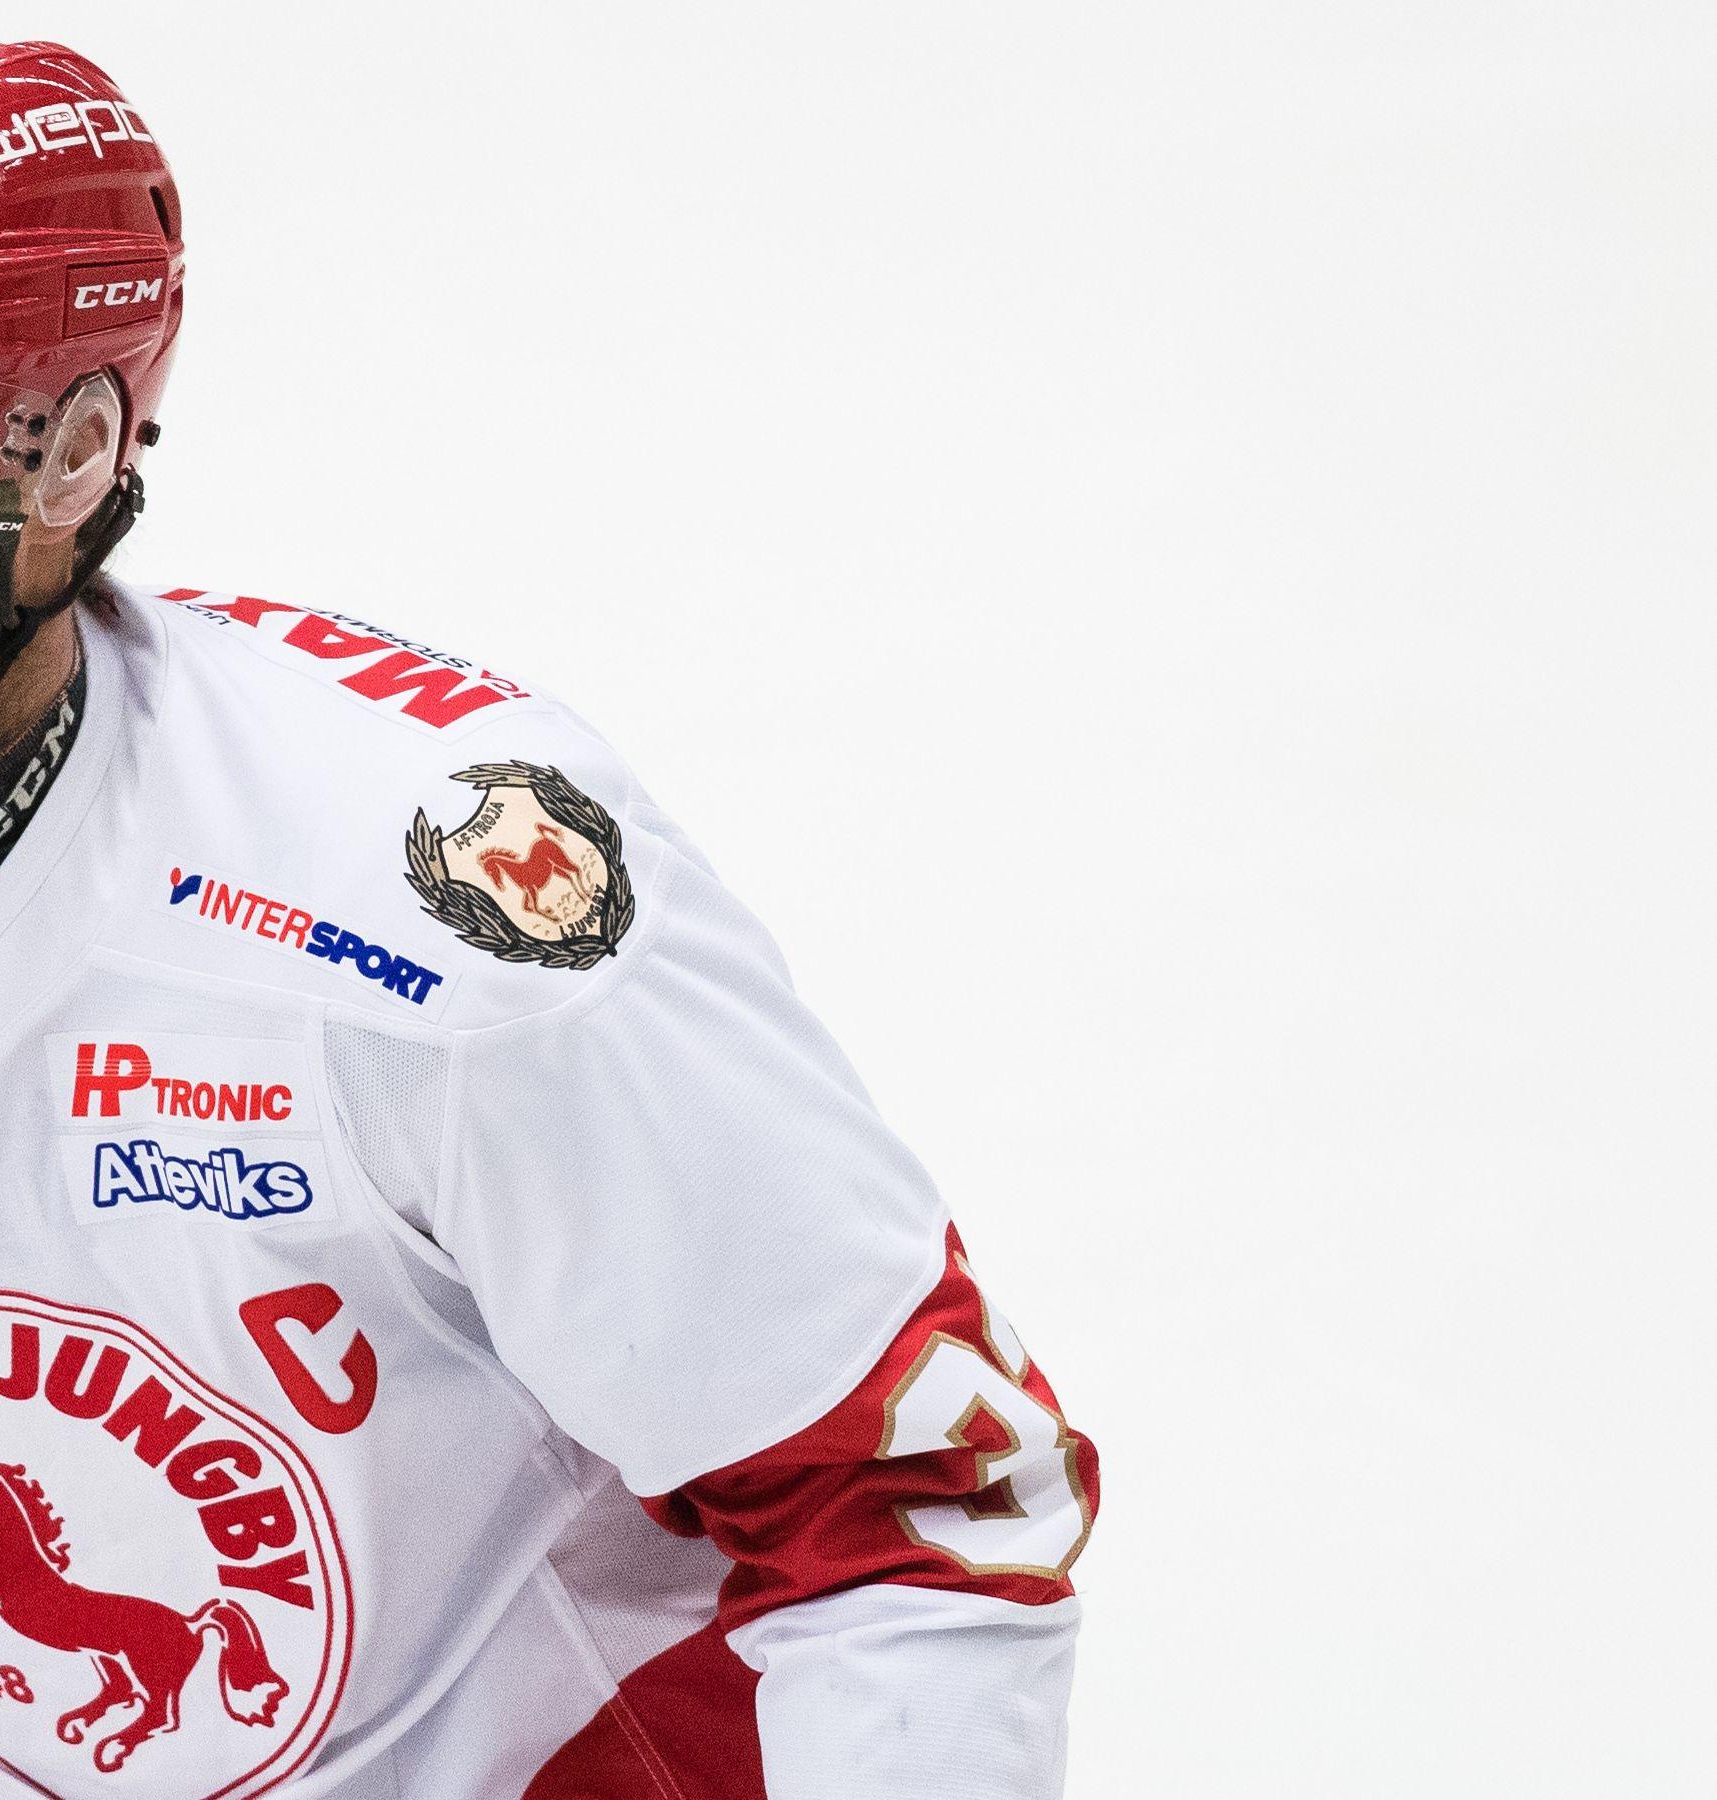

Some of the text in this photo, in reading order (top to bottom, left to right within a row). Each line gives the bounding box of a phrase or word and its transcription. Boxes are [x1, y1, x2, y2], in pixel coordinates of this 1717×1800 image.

[73, 278, 163, 310] CCM
[197, 879, 445, 1006] INTERSPORT
[92, 1139, 314, 1221] Atteviks
[237, 1282, 379, 1436] C
